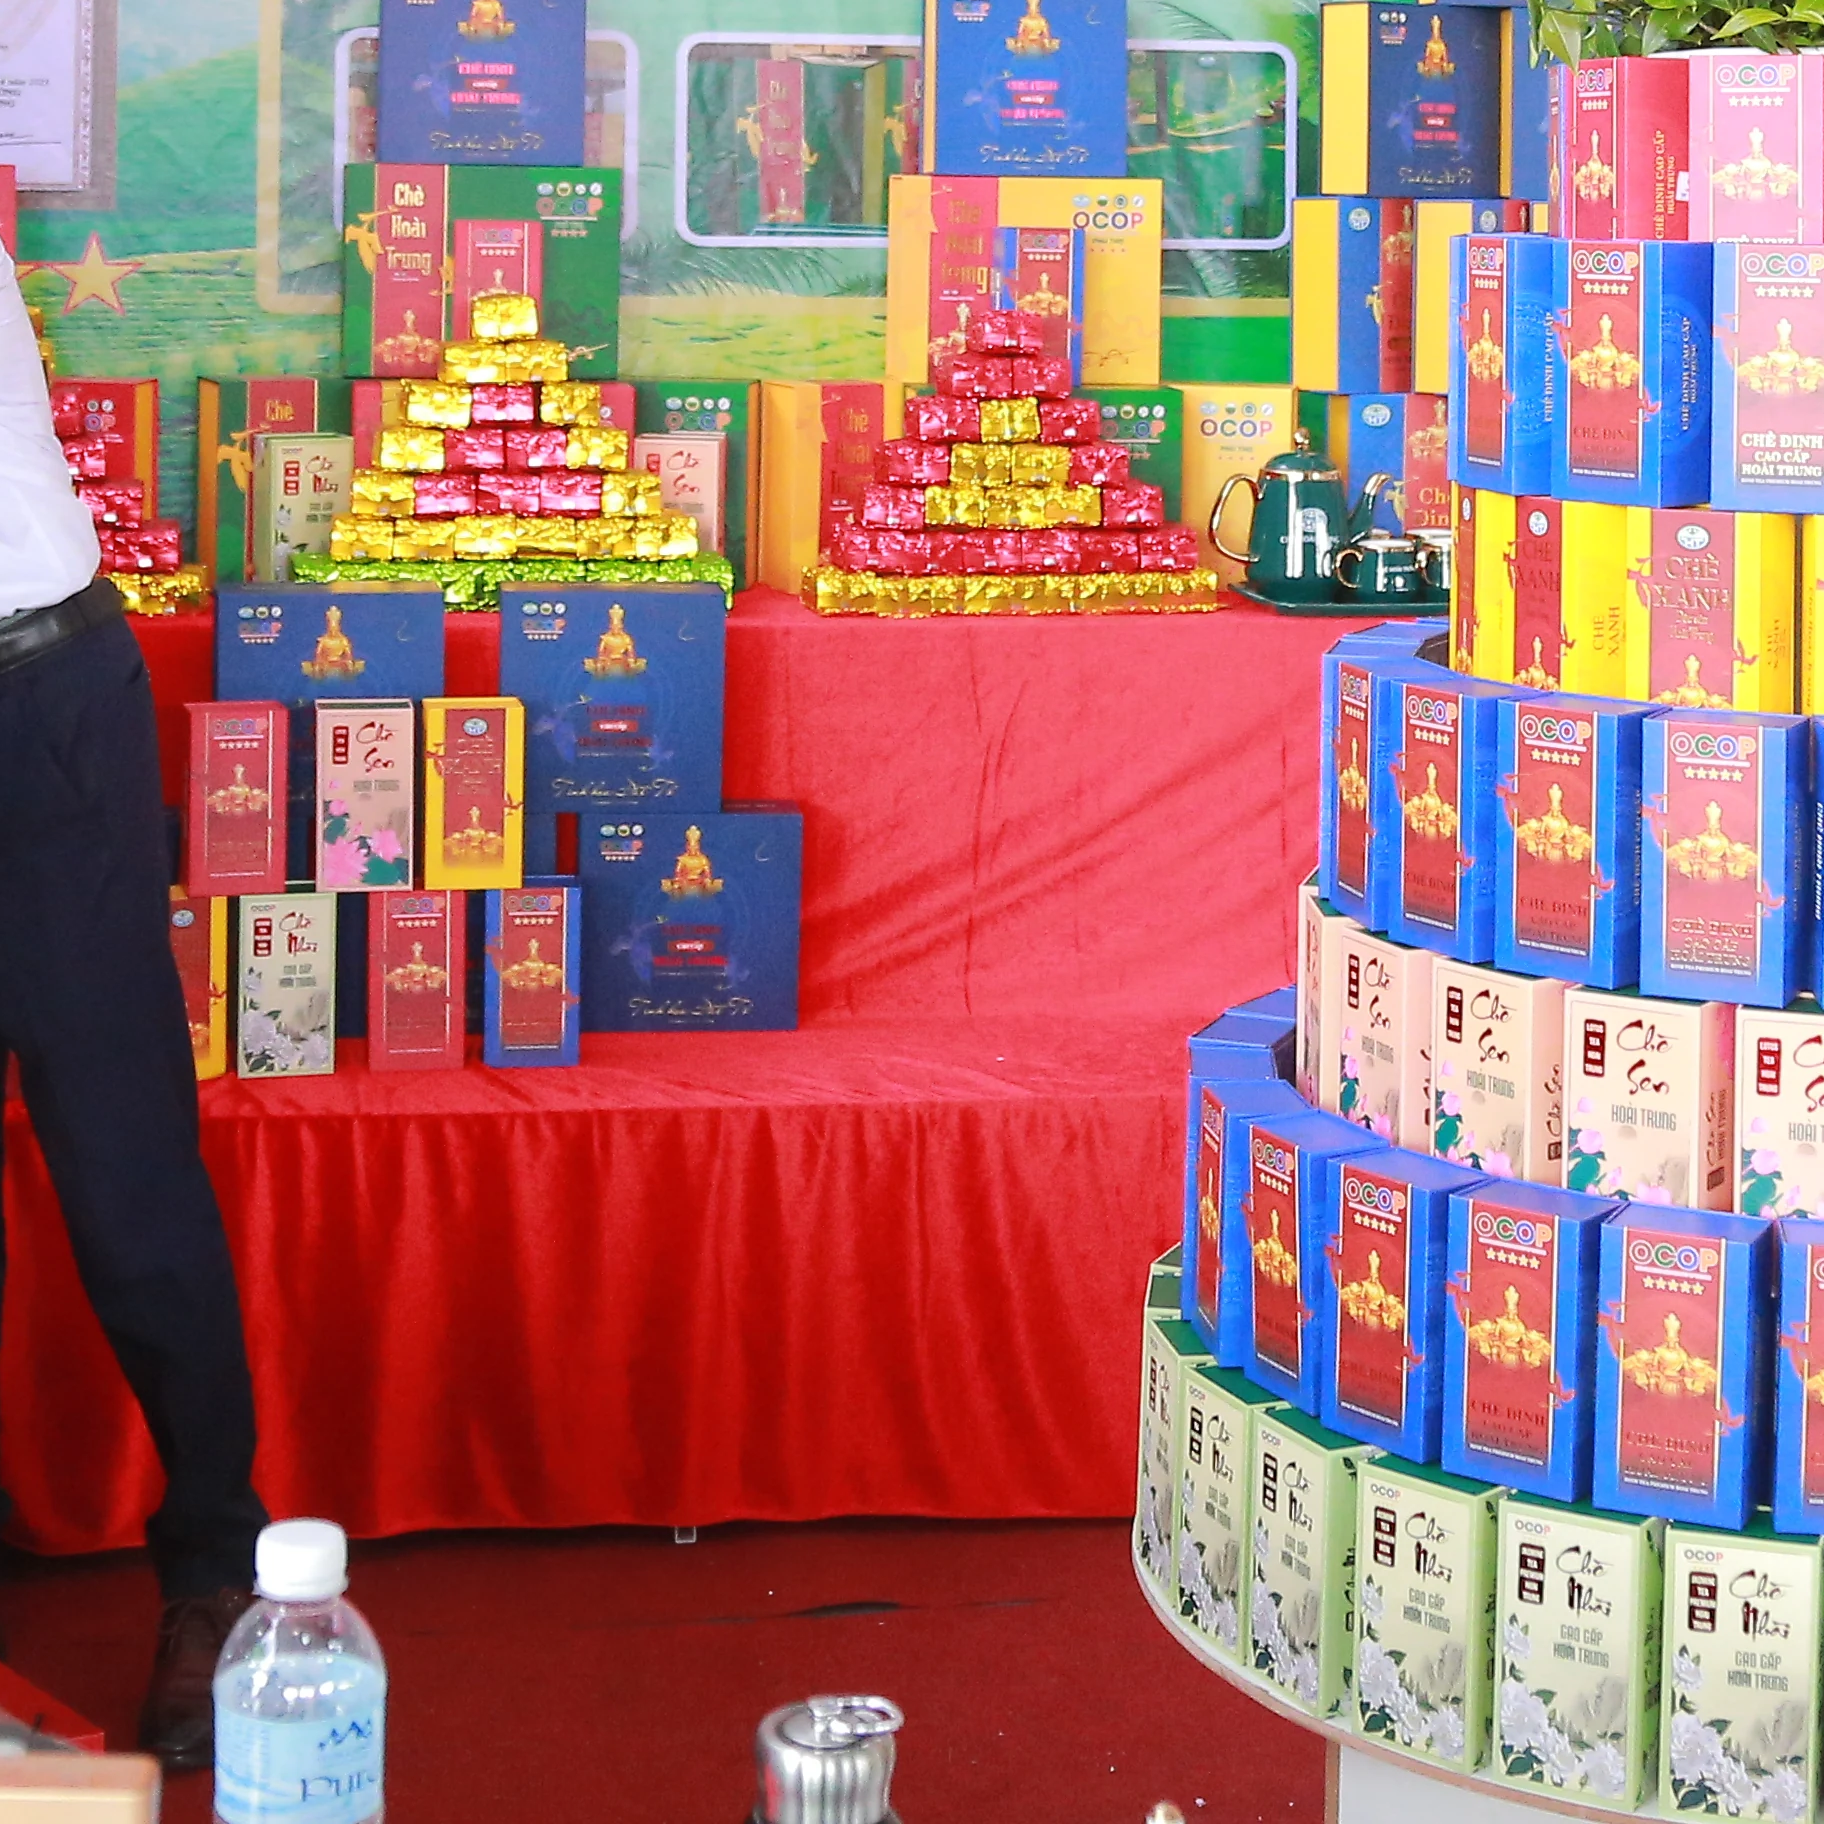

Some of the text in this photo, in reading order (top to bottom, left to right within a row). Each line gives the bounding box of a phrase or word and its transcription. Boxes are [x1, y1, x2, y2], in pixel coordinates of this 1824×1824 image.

[1577, 68, 1612, 92] OCOP
[1716, 64, 1795, 86] OCOP
[394, 182, 425, 207] Chè
[391, 215, 426, 239] Hoài
[1072, 211, 1144, 231] OCOP
[386, 246, 432, 275] Trung
[1469, 246, 1503, 270] OCOP
[1573, 250, 1639, 275] OCOP
[1199, 417, 1274, 440] OCOP
[1742, 430, 1777, 448] CHÈ
[1754, 448, 1810, 464] CAO CẤP
[1742, 463, 1823, 477] HOÀI TRUNG
[1671, 732, 1756, 758] OCOP
[1788, 1119, 1818, 1143] HOÀI
[1630, 1240, 1718, 1270] OCOP
[1683, 1549, 1723, 1564] OCOP
